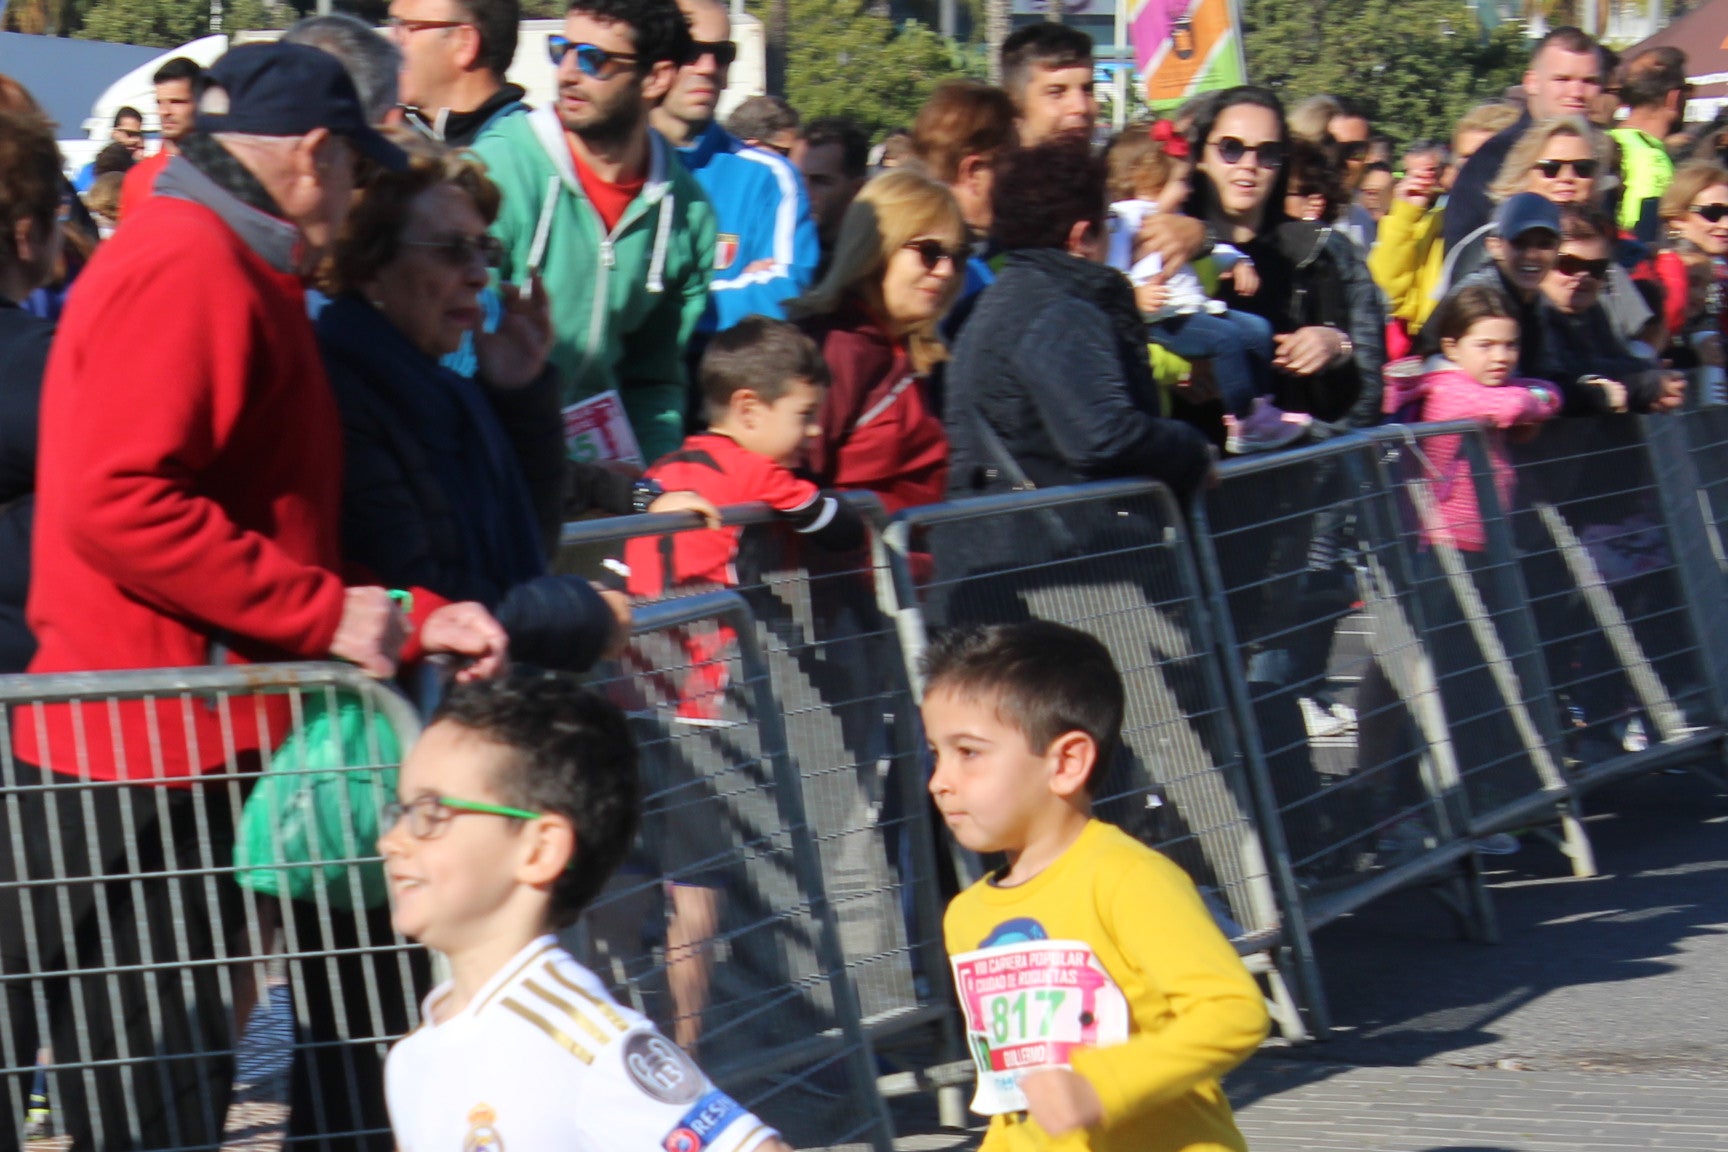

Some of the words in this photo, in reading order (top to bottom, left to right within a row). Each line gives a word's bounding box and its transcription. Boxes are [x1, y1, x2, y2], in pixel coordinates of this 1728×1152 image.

[988, 953, 1028, 974] CARRERA
[1029, 949, 1086, 968] POPULAR
[975, 974, 1007, 994] CIUDAD
[1018, 967, 1079, 986] ROQUETAS
[991, 990, 1066, 1044] 817
[1003, 1045, 1046, 1068] GUILLERMO
